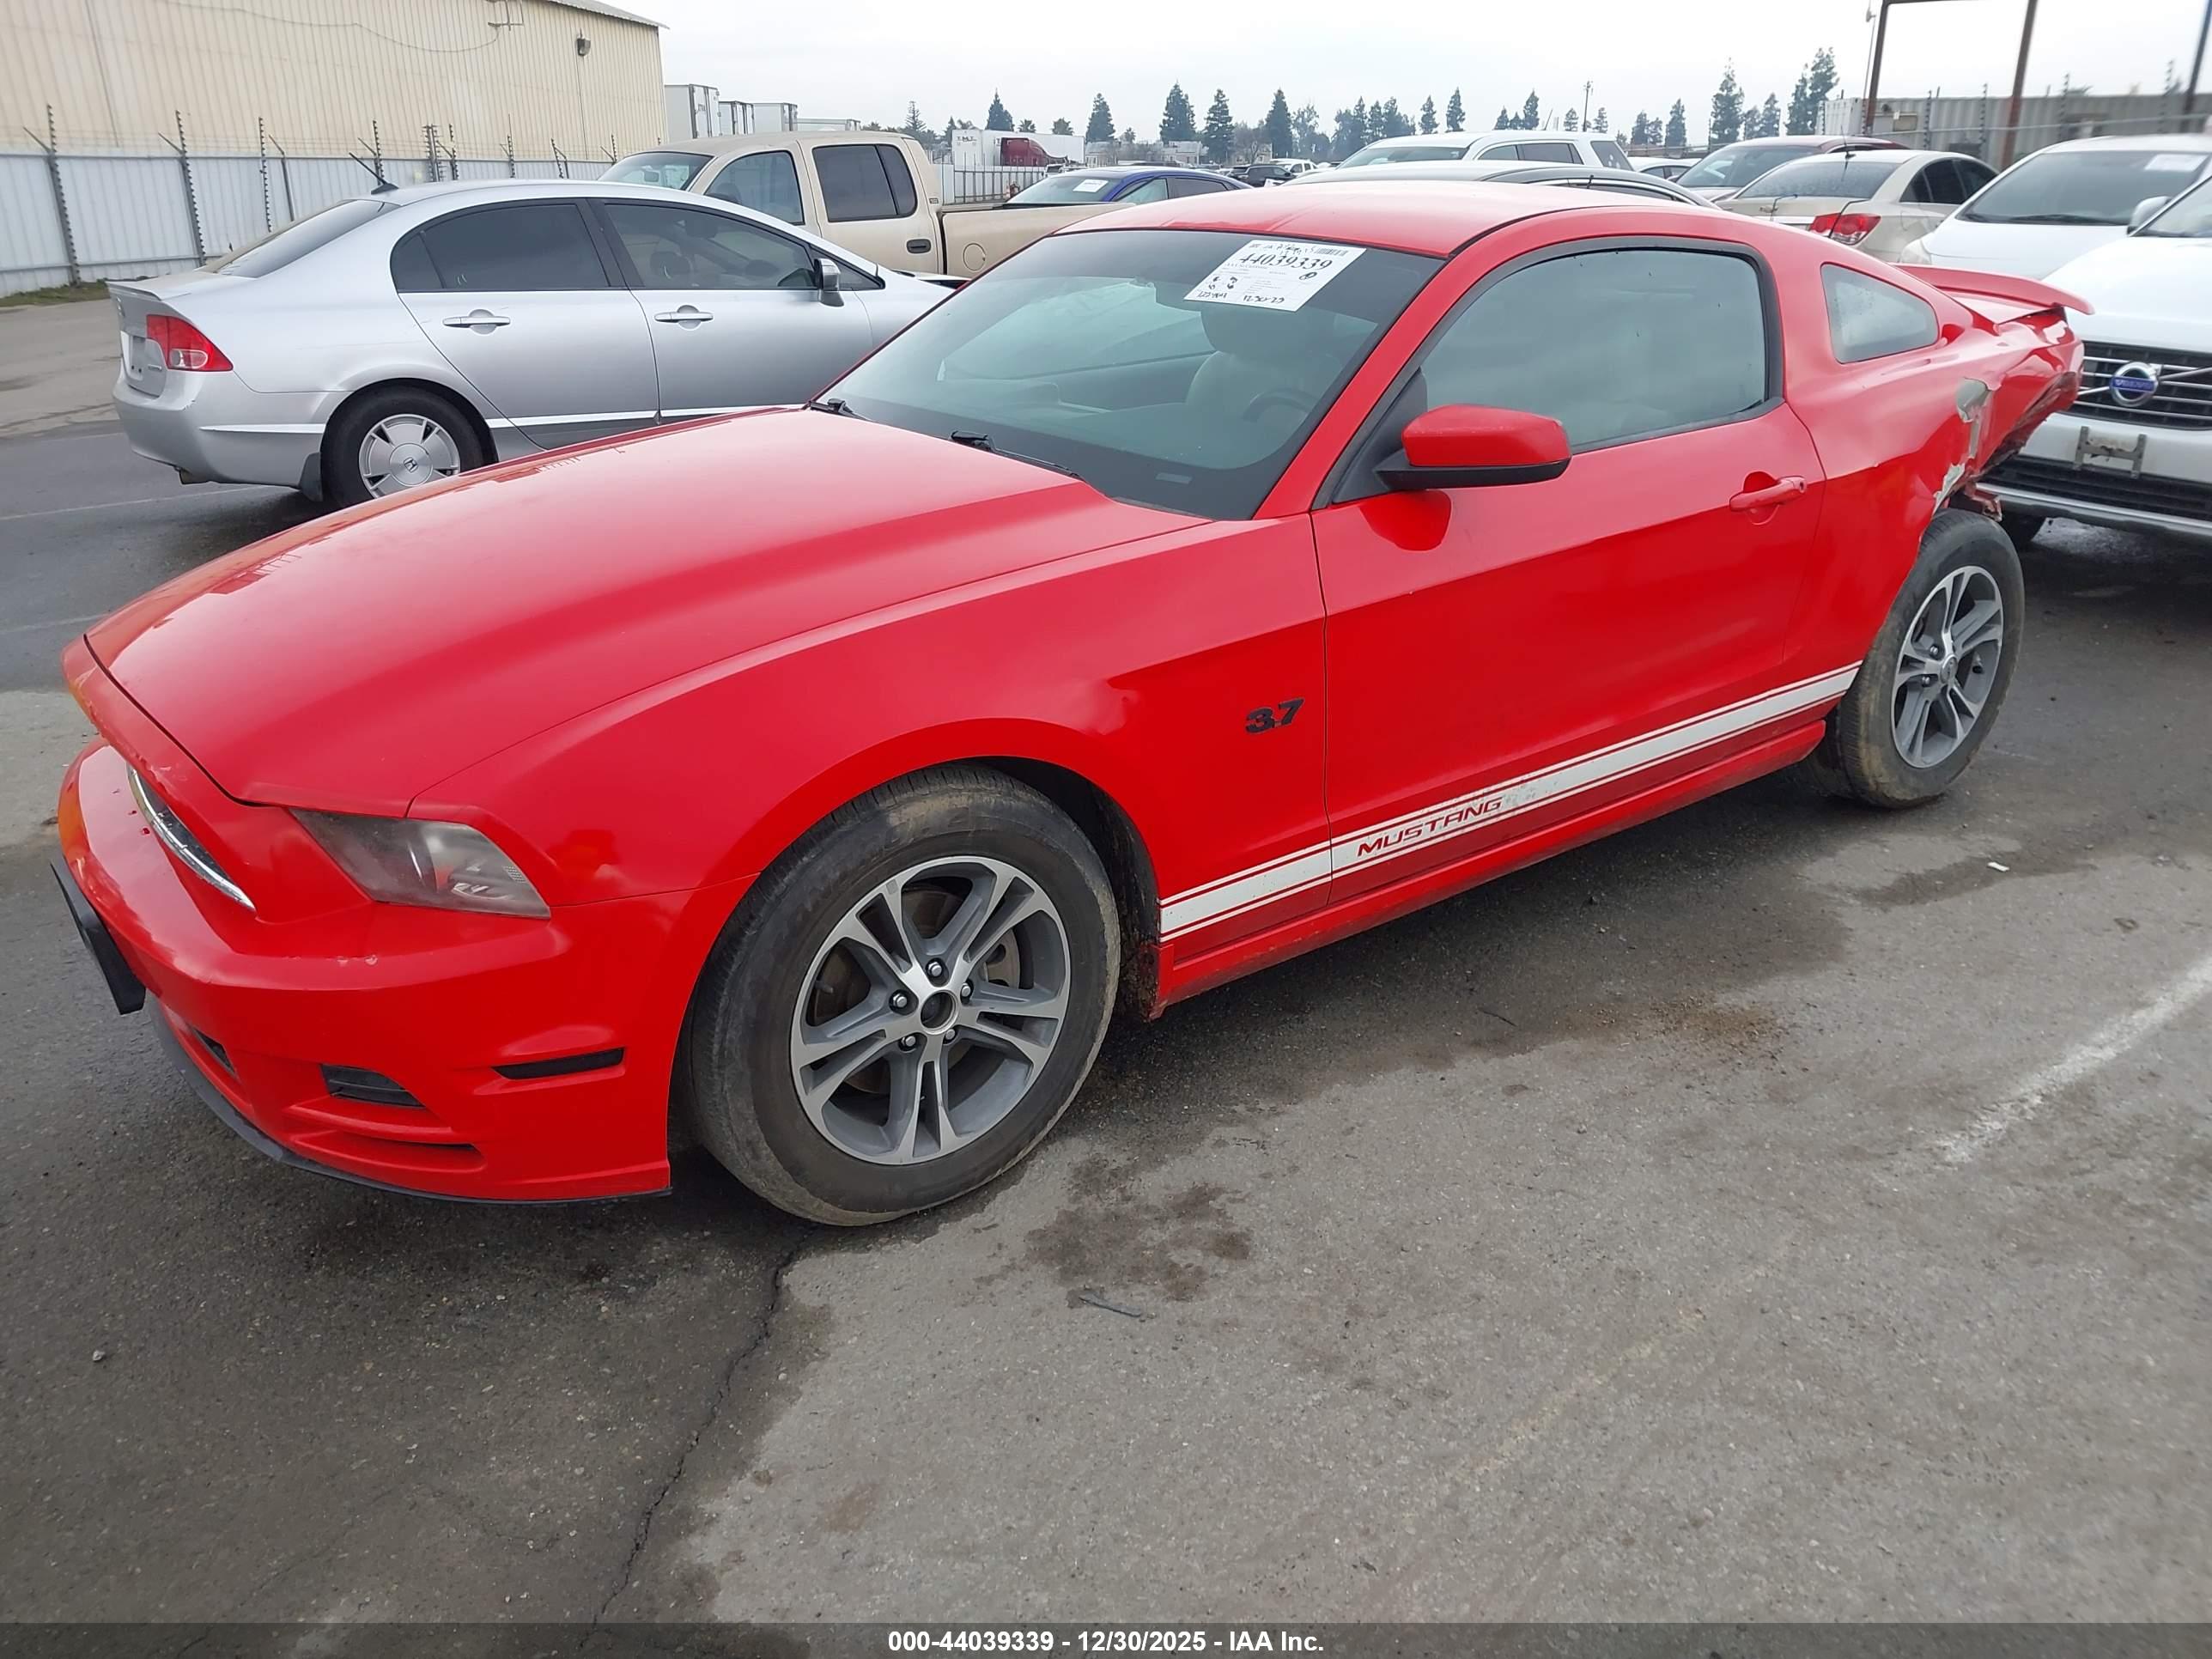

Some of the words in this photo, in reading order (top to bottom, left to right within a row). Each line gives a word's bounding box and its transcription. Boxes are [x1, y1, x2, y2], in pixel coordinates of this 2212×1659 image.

[1239, 252, 1333, 270] 44039339
[1245, 697, 1305, 733] 3.7
[1358, 798, 1503, 856] MUSTANG
